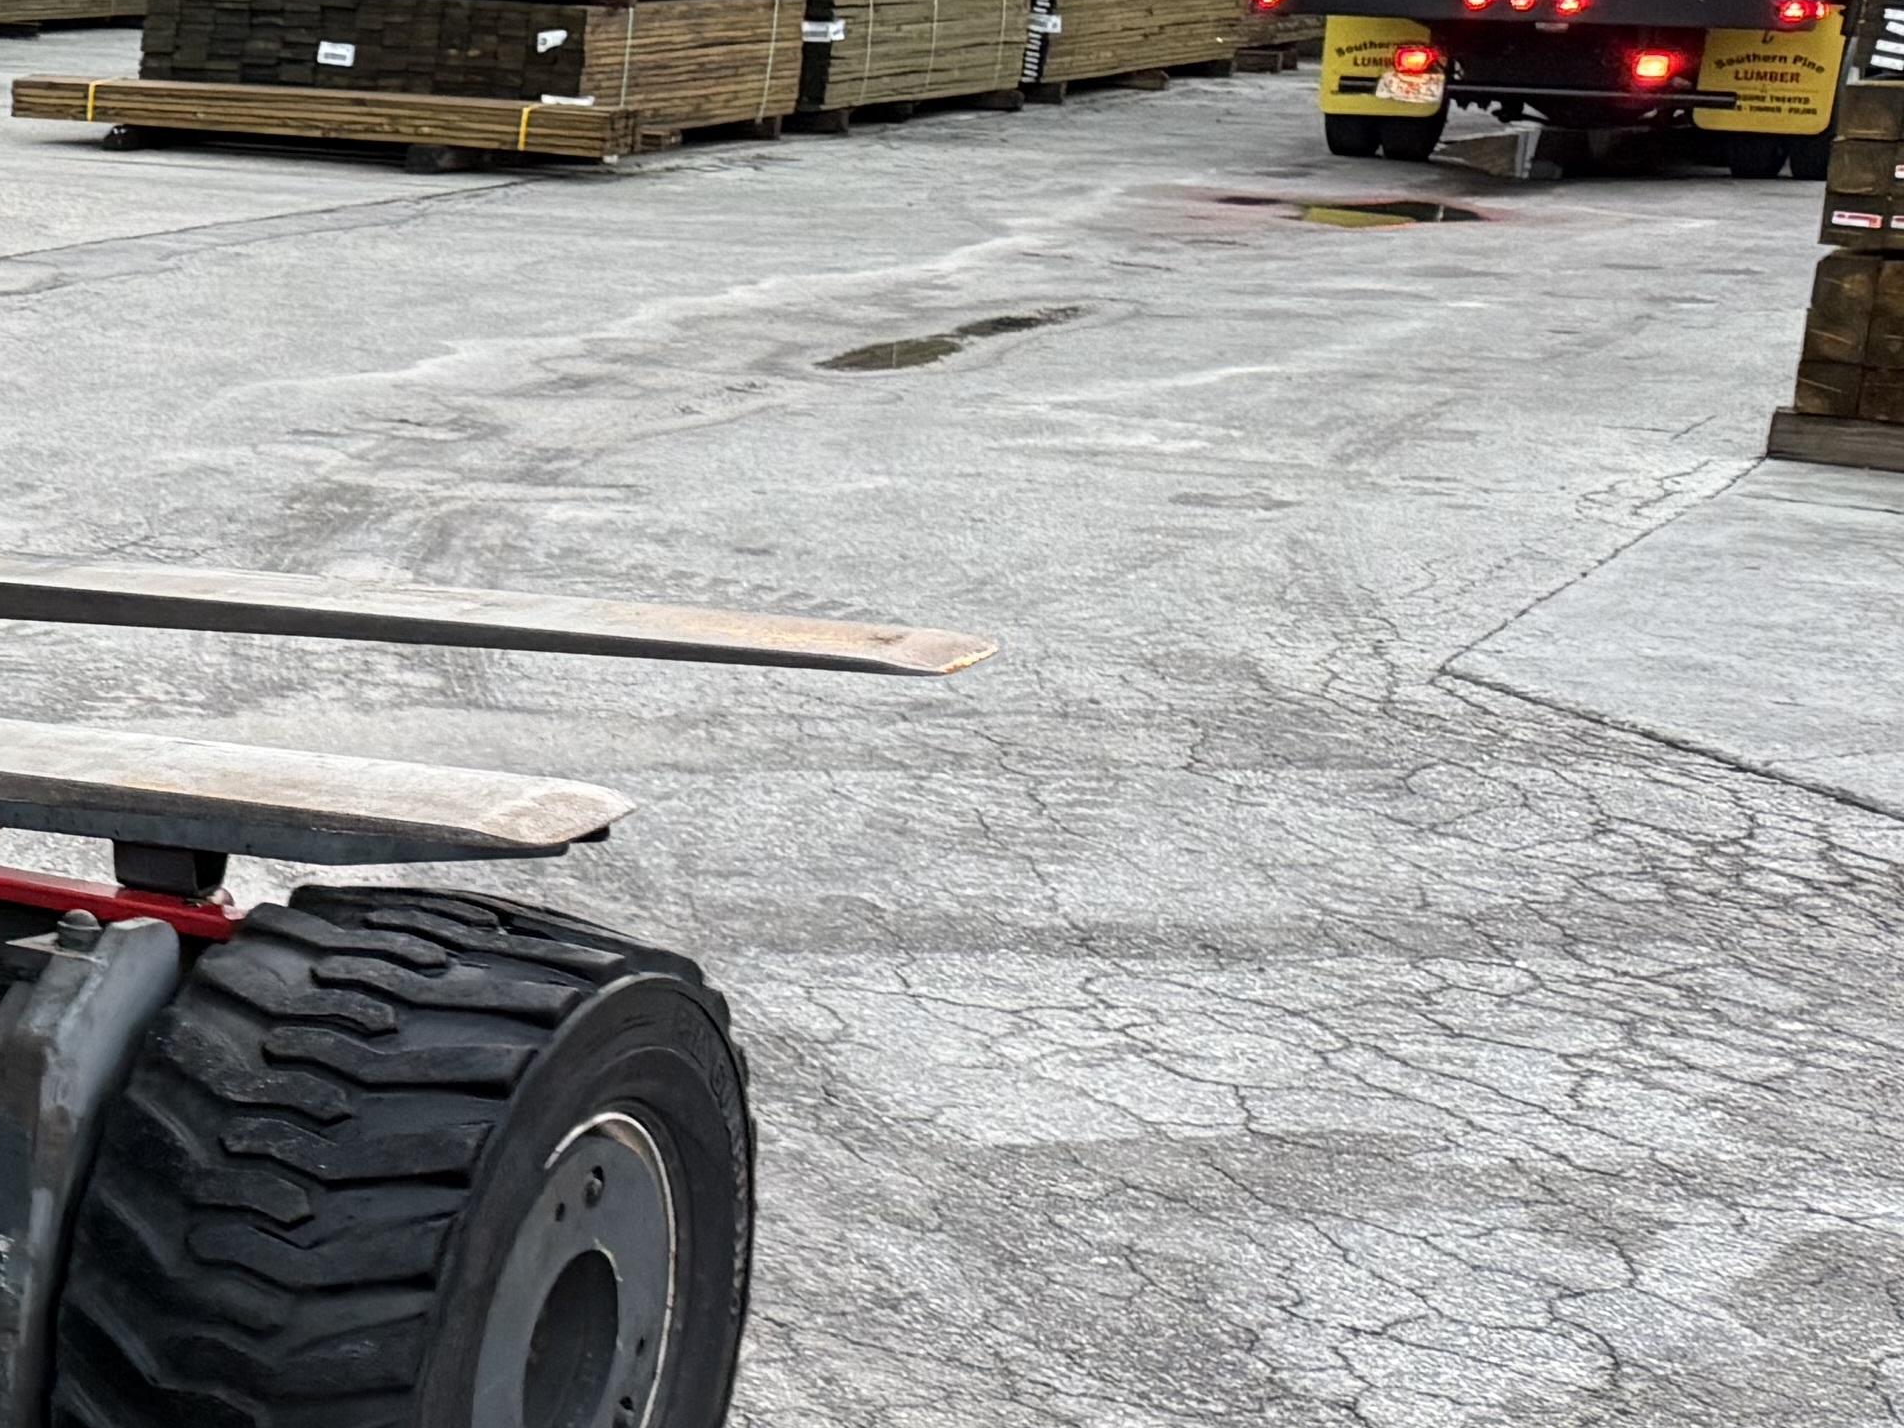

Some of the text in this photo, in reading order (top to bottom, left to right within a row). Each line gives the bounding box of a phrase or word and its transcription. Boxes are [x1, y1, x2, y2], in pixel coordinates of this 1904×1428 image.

[1715, 53, 1825, 74] Southern Pine
[1734, 70, 1801, 83] LUMBER
